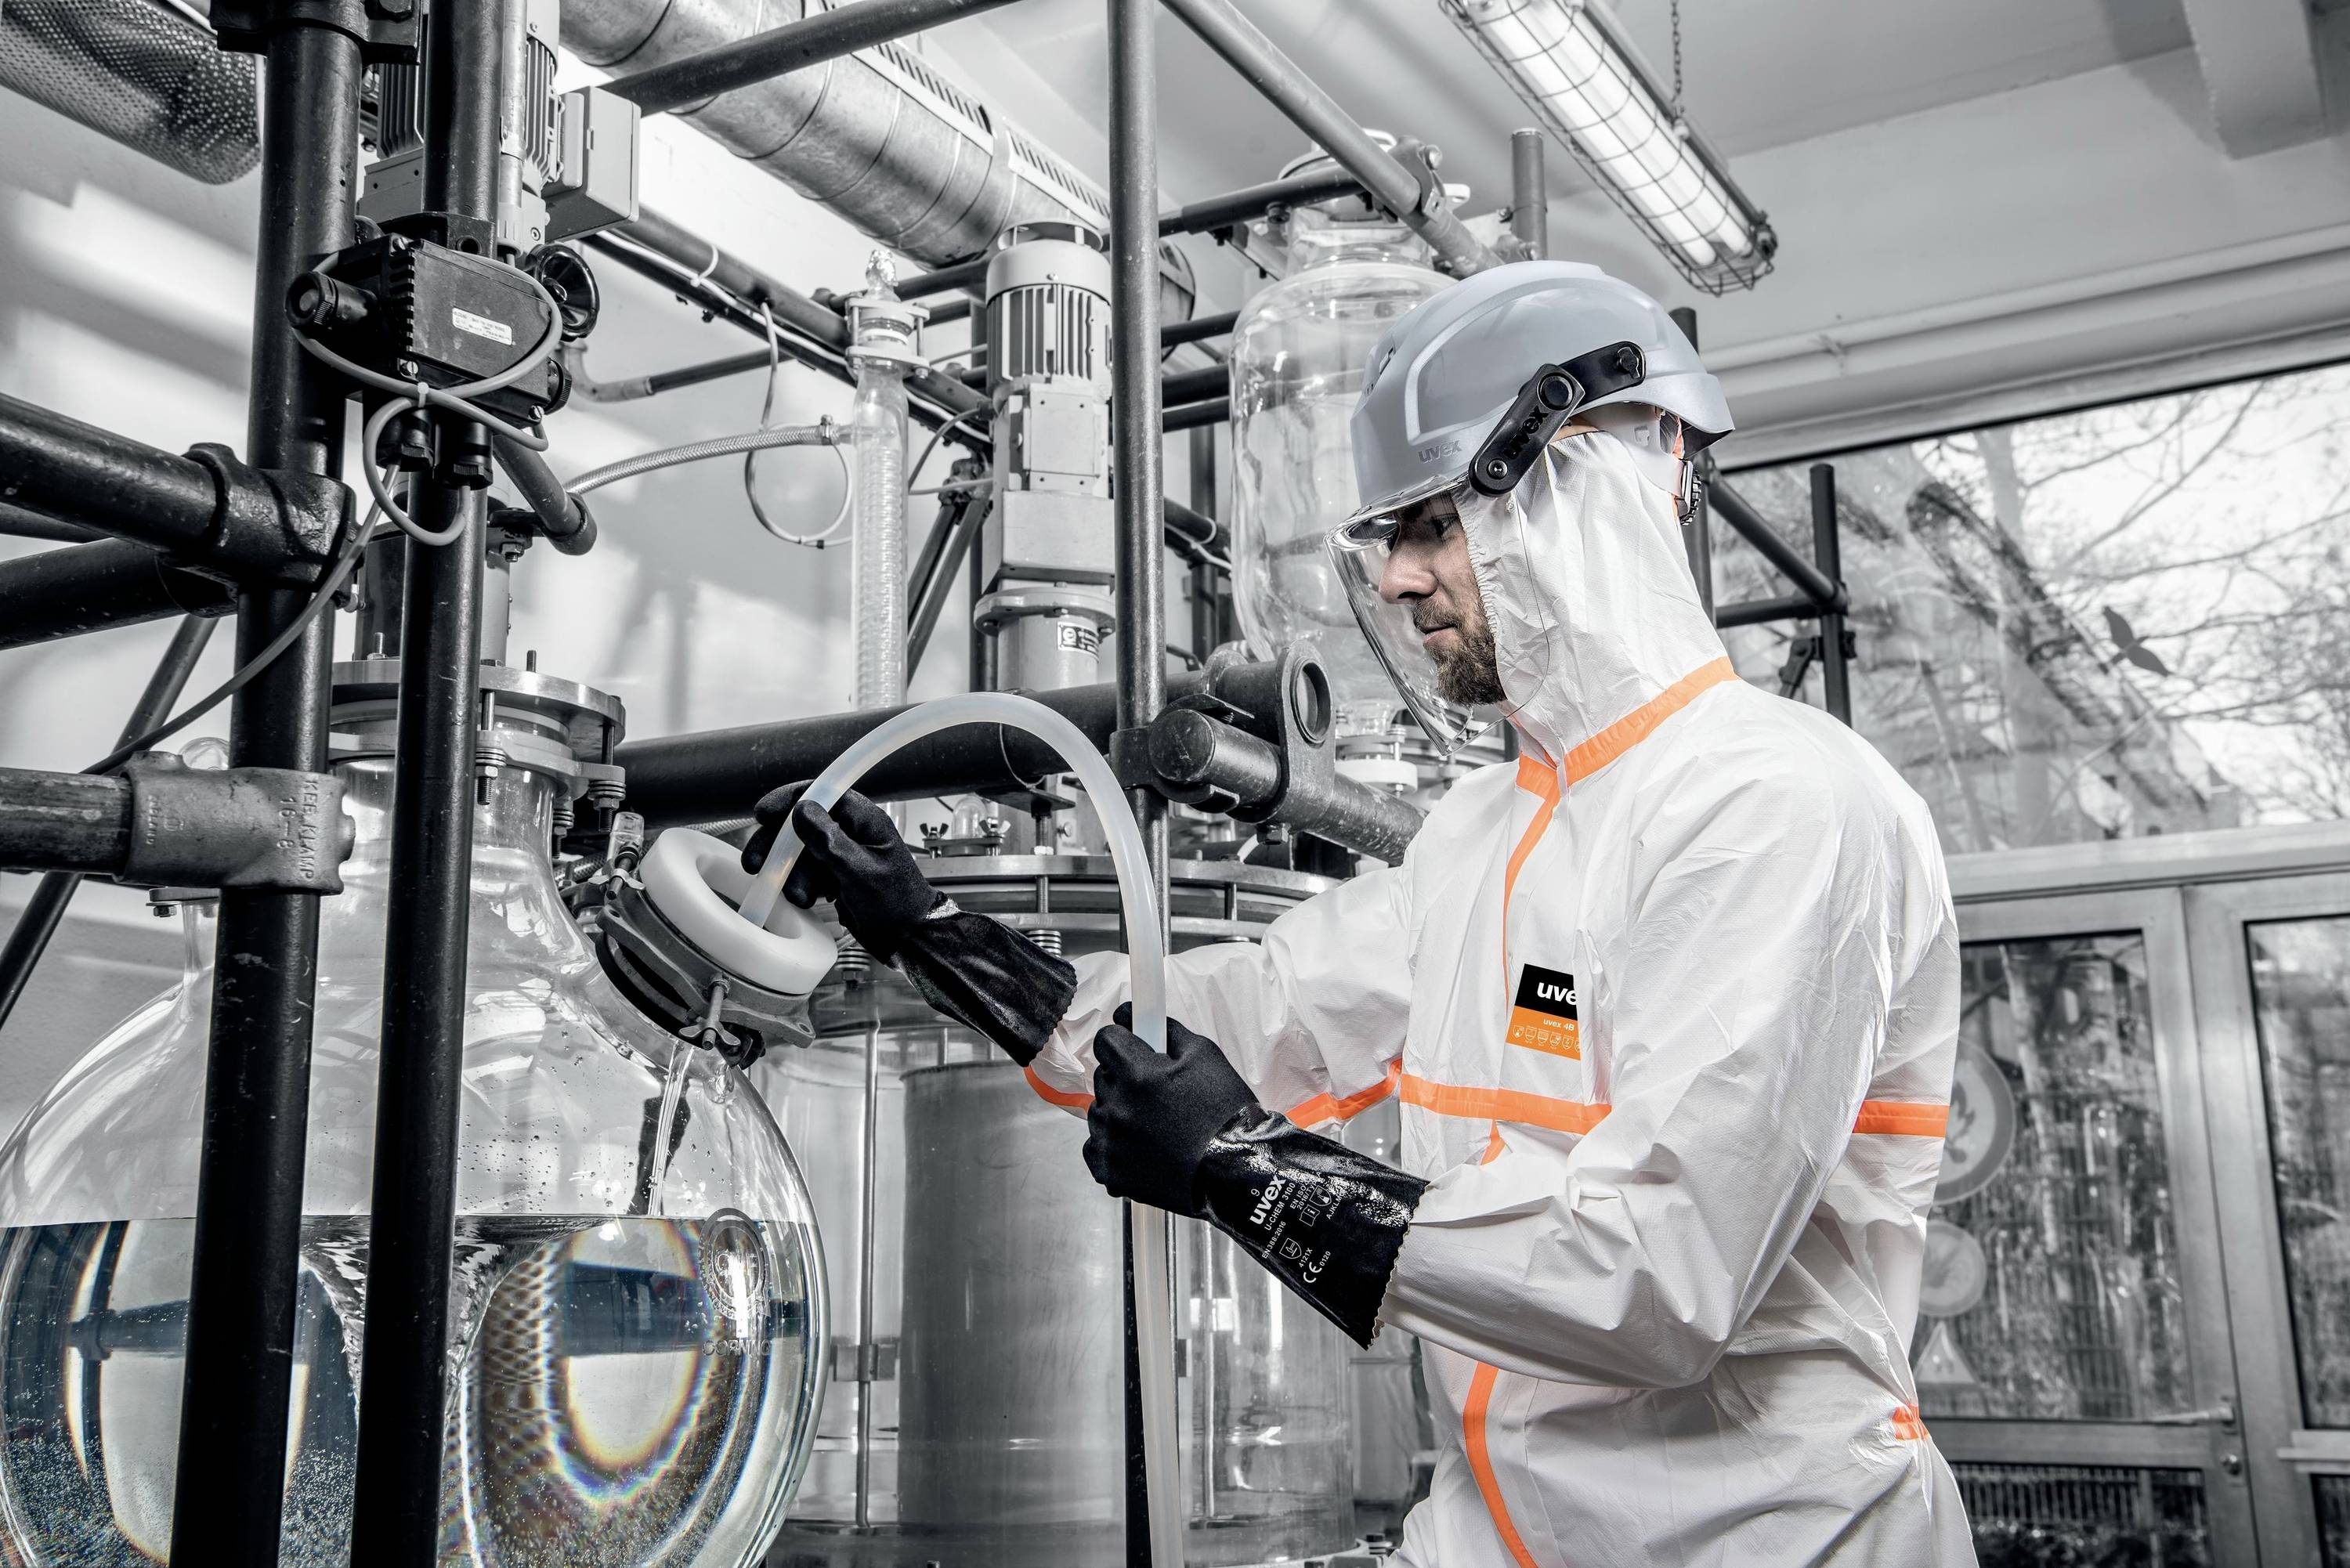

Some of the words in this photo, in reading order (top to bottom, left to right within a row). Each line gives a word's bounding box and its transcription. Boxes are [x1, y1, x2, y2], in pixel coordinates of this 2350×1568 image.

[1503, 405, 1549, 460] uvex
[1418, 439, 1462, 464] uvex
[302, 781, 318, 814] KEE
[298, 823, 317, 879] KLAMP
[1537, 982, 1577, 1006] uve
[1543, 1019, 1562, 1029] uvex
[1249, 1175, 1287, 1225] uvex
[1250, 1188, 1260, 1197] 9
[1264, 1201, 1285, 1231] U-CHEM
[1282, 1182, 1296, 1201] 3100
[1289, 1198, 1300, 1209] EN
[1296, 1184, 1307, 1198] ISO
[1296, 1179, 1318, 1210] 2016/Typ
[1298, 1247, 1313, 1268] 4121X
[1303, 1261, 1322, 1284] CE
[1319, 1251, 1332, 1267] 0120
[702, 1339, 772, 1357] CORNING
